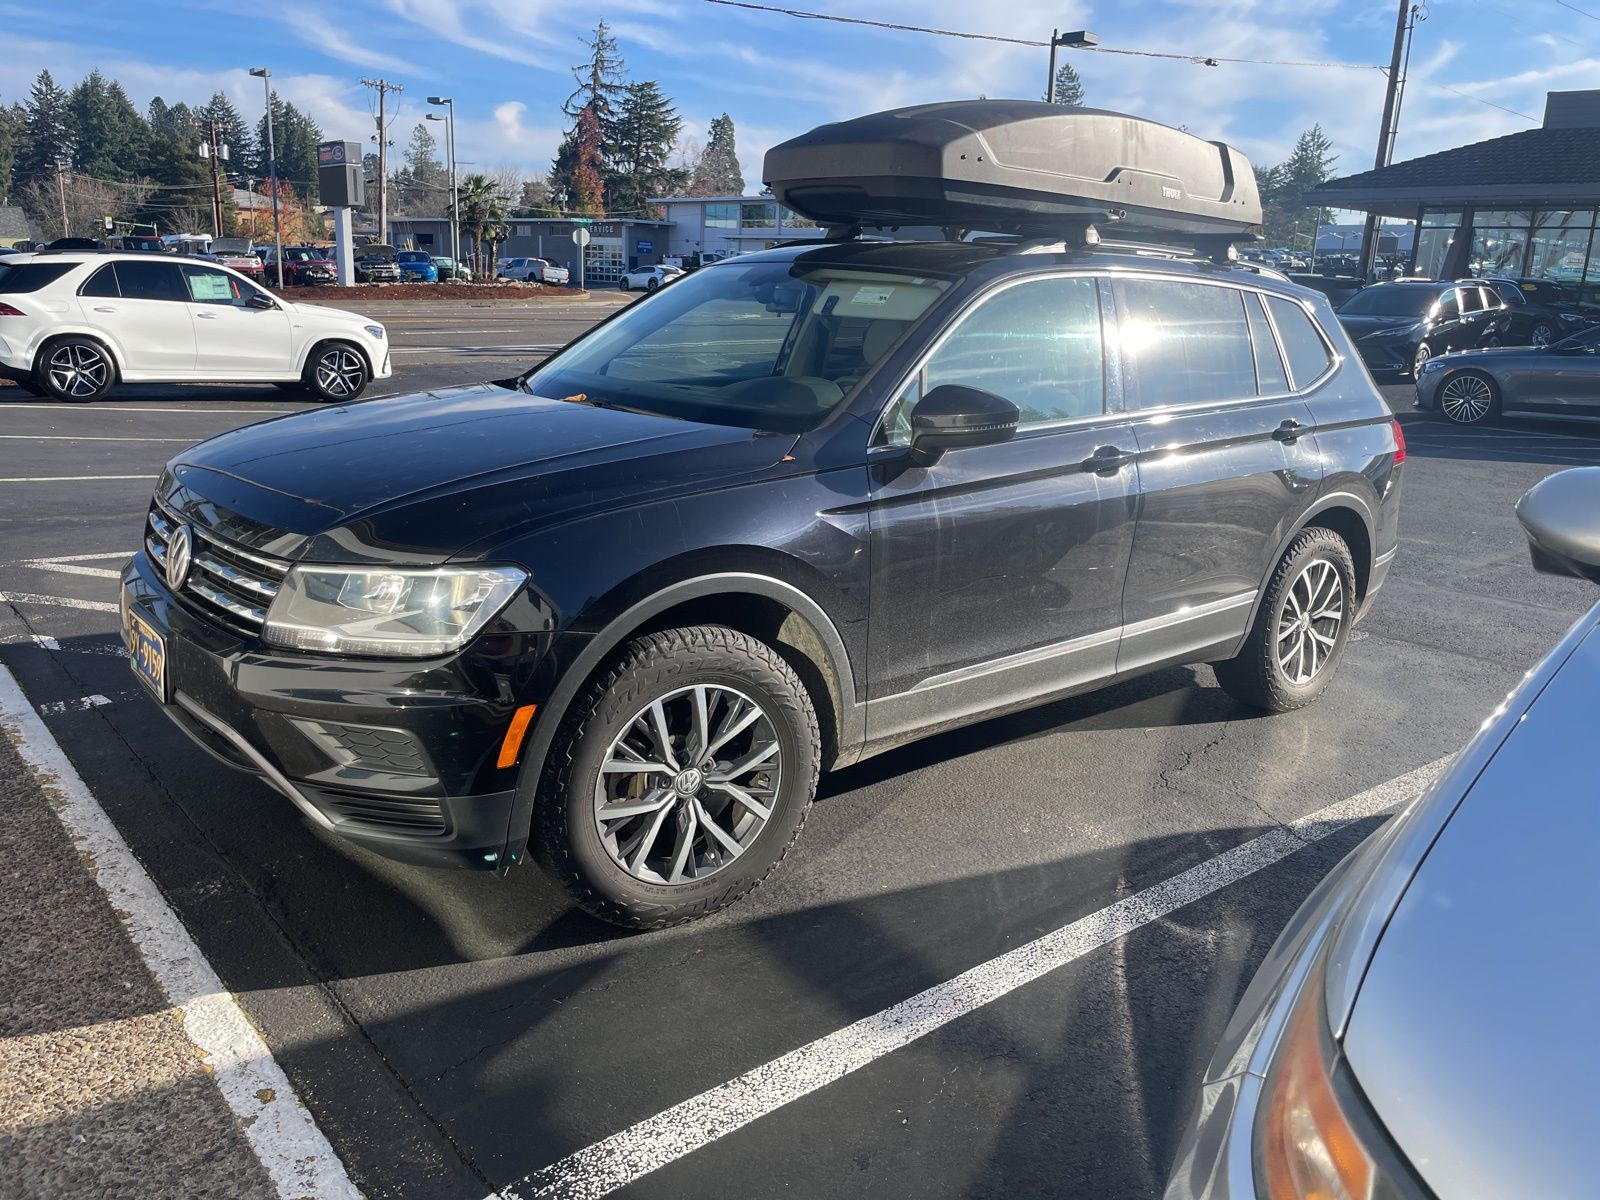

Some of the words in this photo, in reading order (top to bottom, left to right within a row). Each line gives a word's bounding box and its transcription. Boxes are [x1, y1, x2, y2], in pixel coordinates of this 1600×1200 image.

[1162, 186, 1181, 200] THULE
[588, 225, 614, 233] ERVICE
[678, 769, 700, 794] VW
